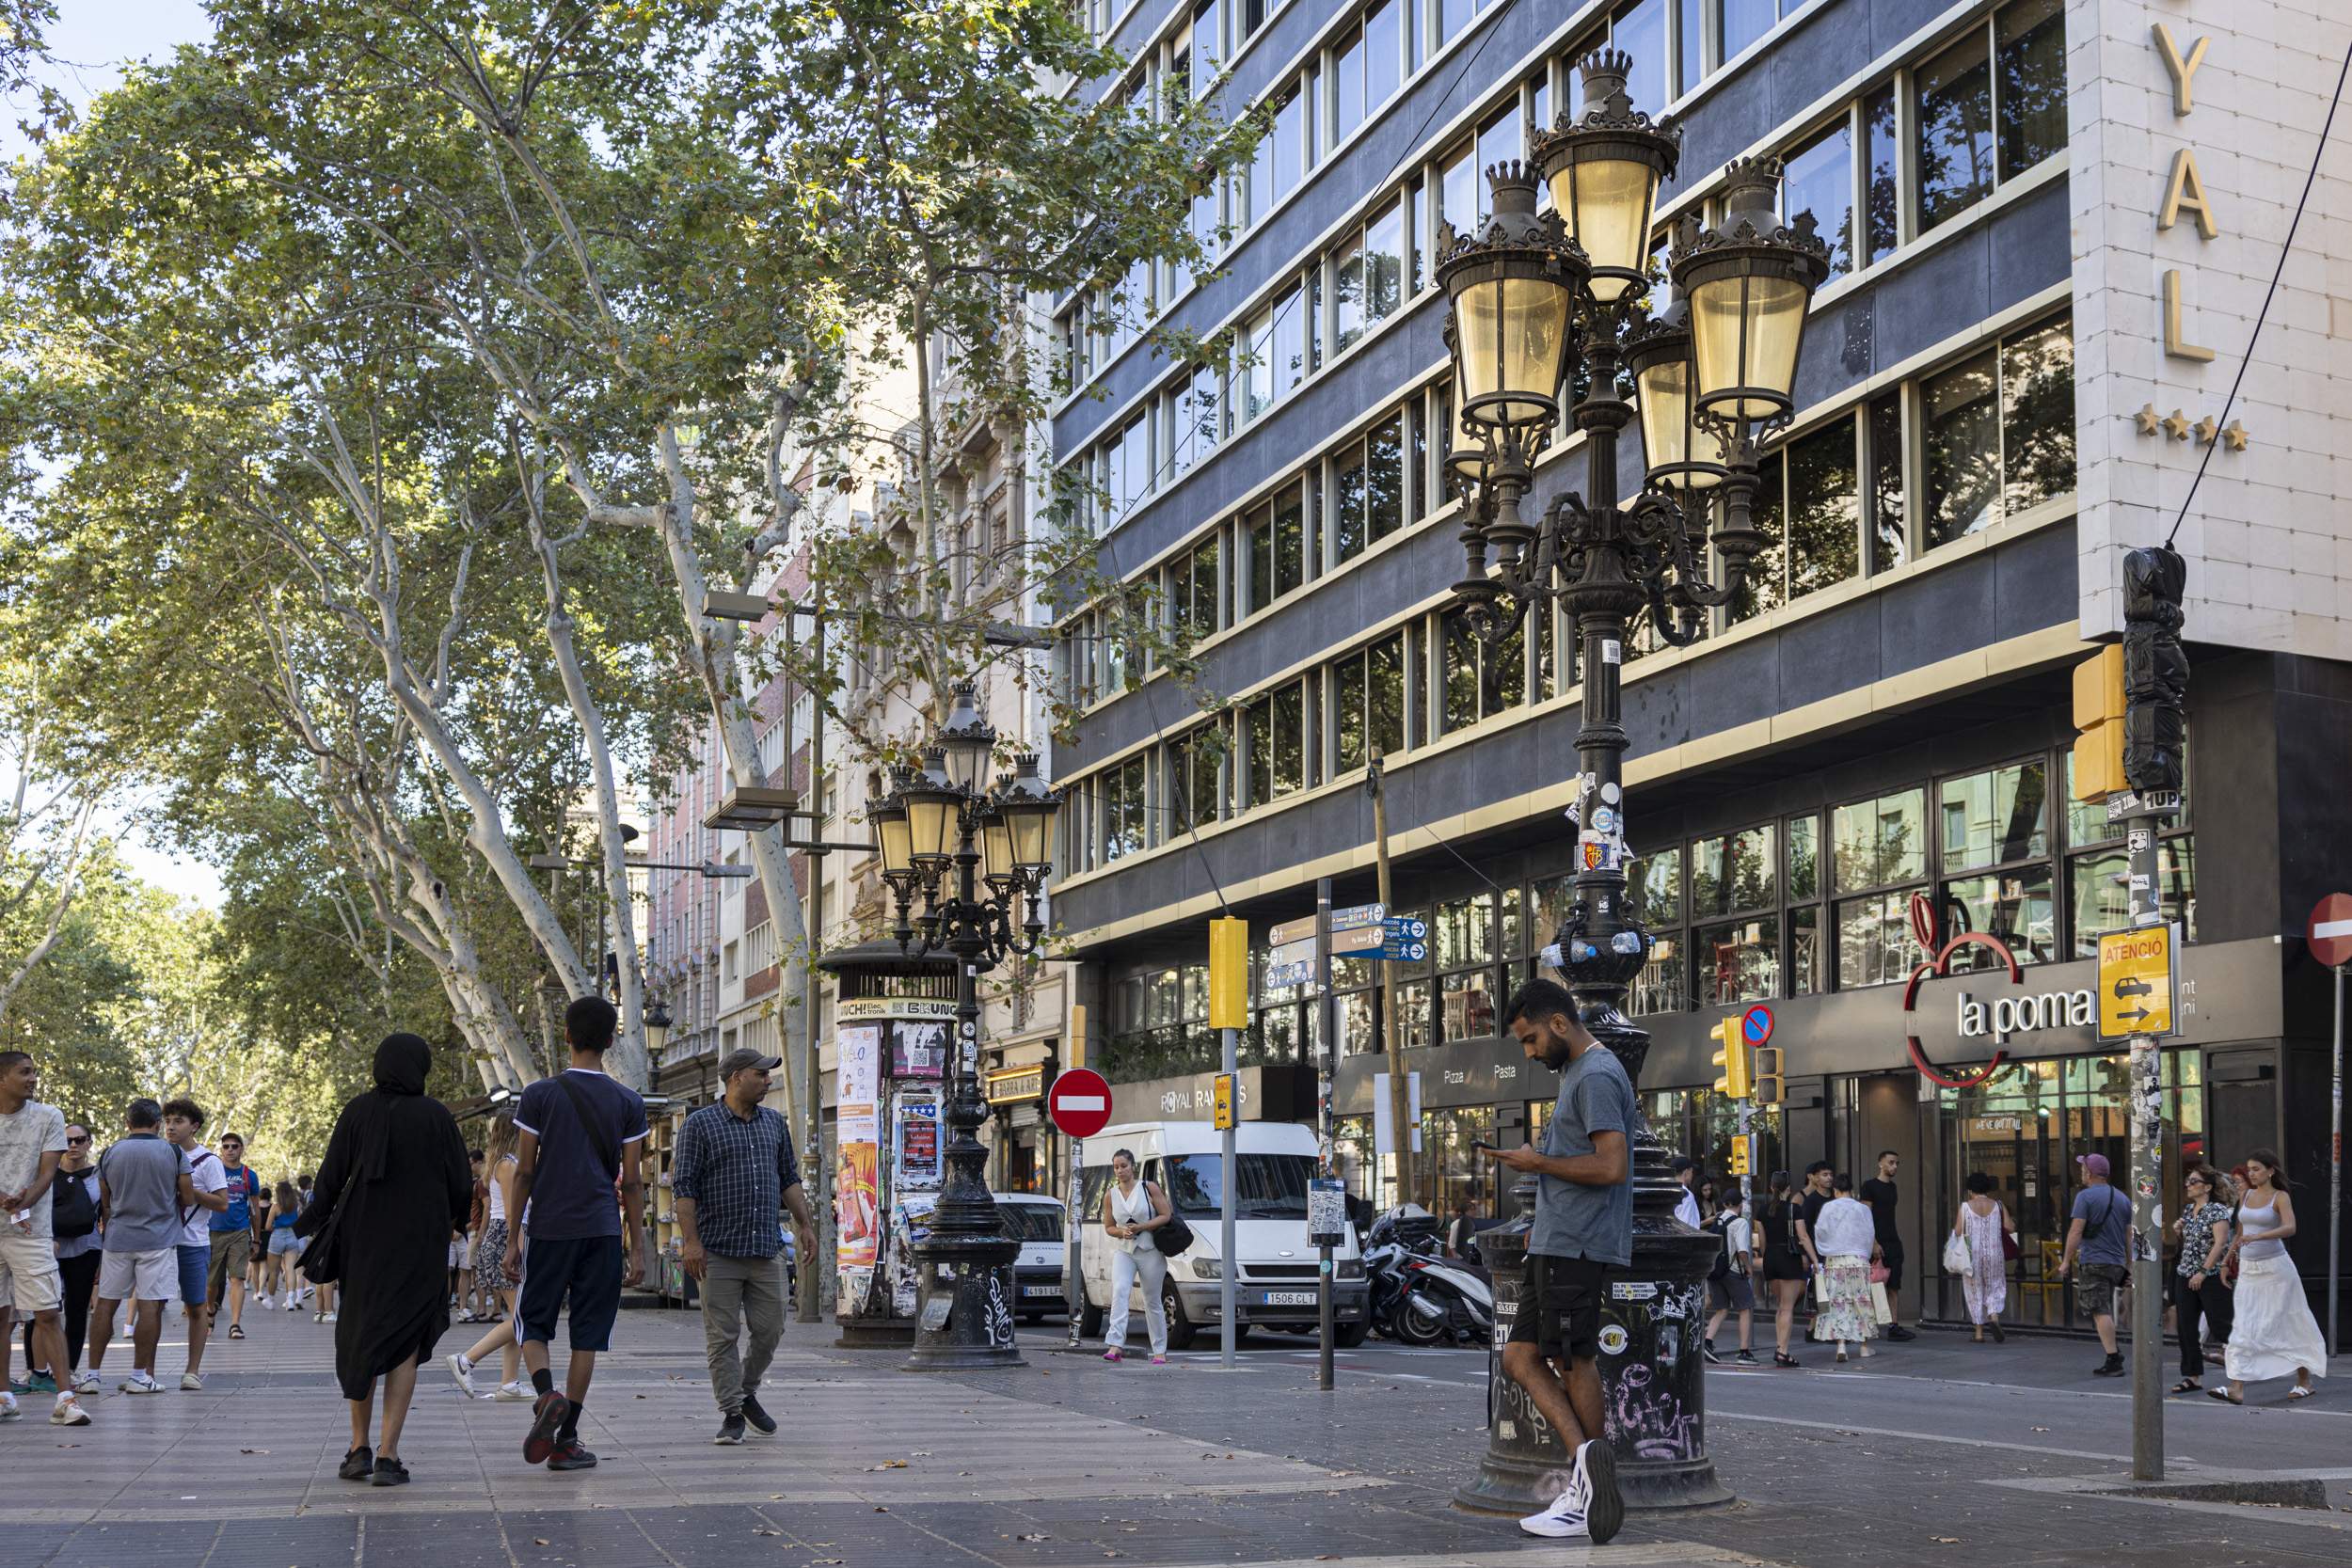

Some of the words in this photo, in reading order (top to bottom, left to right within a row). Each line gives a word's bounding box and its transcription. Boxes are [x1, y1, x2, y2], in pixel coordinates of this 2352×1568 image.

[2146, 791, 2178, 808] 1UP
[2105, 937, 2163, 963] ATENCIÓ
[1958, 991, 1988, 1037] la
[1994, 989, 2097, 1044] poma
[1444, 1070, 1464, 1084] Pizza
[1494, 1065, 1516, 1079] Pasta
[1161, 1091, 1192, 1114] ROYAL
[1271, 1293, 1294, 1304] 1506
[1295, 1293, 1314, 1304] CLT
